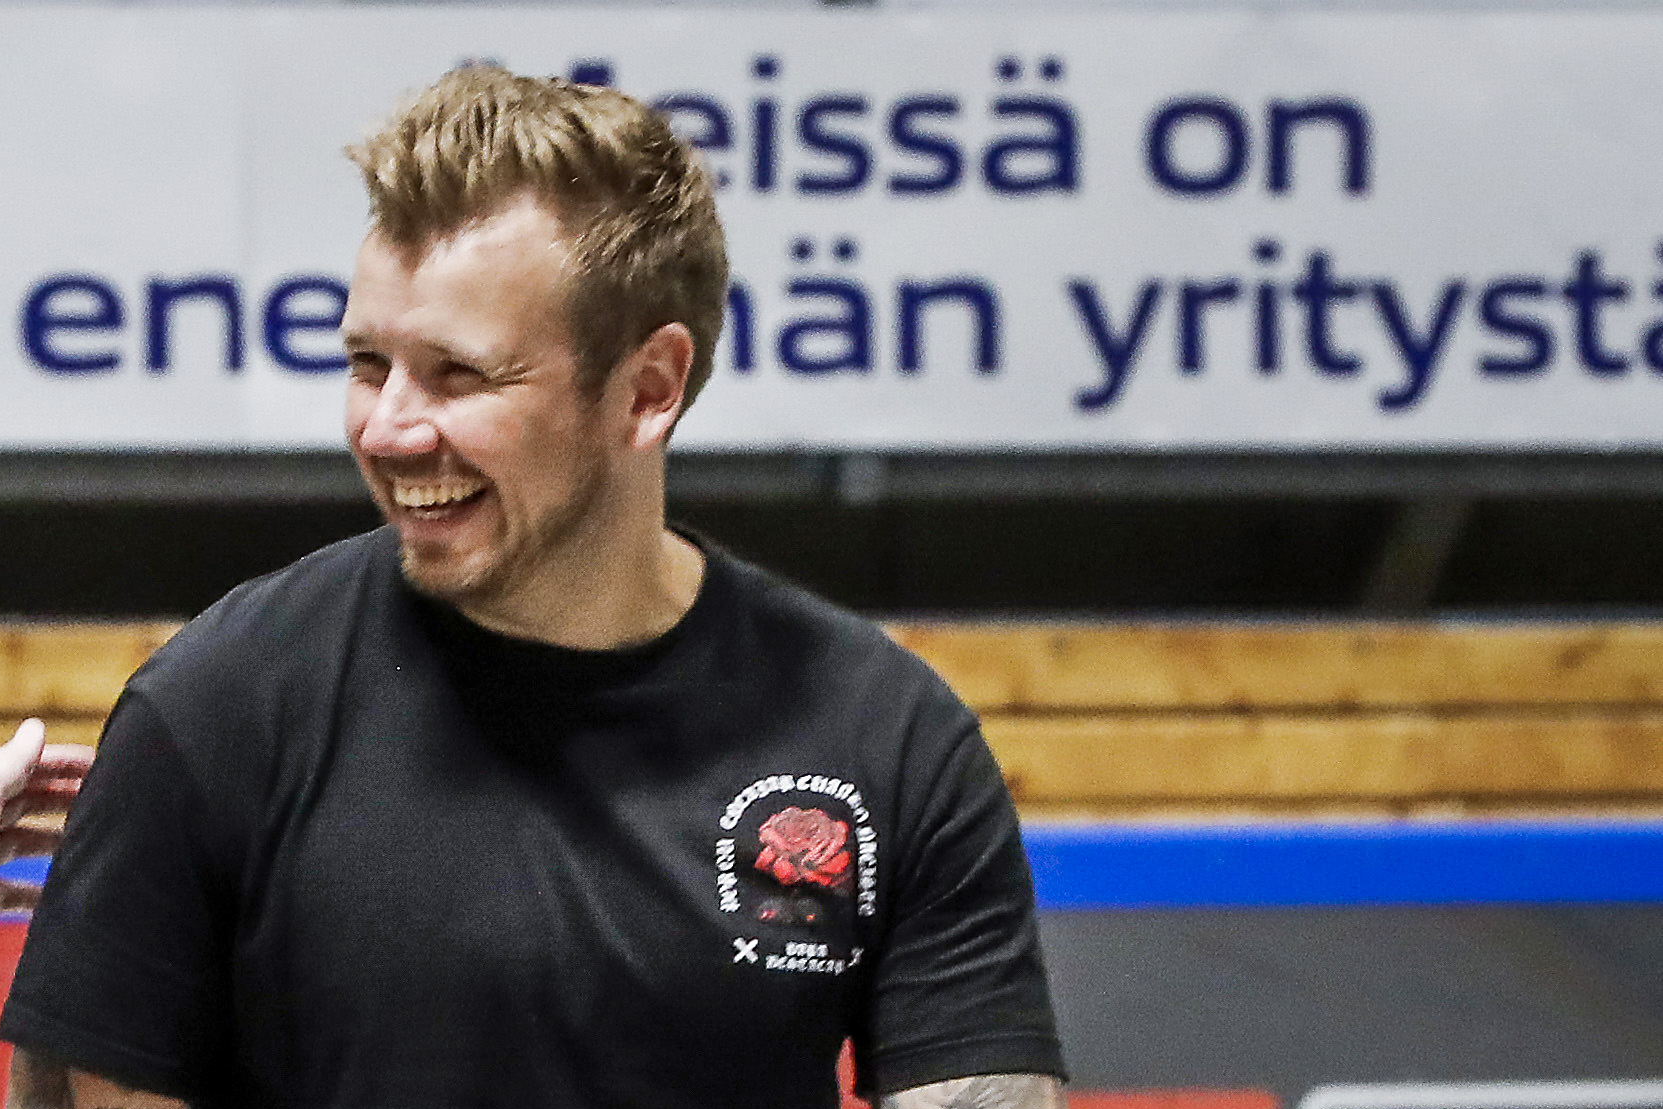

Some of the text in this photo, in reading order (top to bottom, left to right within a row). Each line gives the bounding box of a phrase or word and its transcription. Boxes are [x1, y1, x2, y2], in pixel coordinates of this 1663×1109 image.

[458, 56, 1374, 197] eissä on
[19, 238, 1663, 413] eneän yrityst
